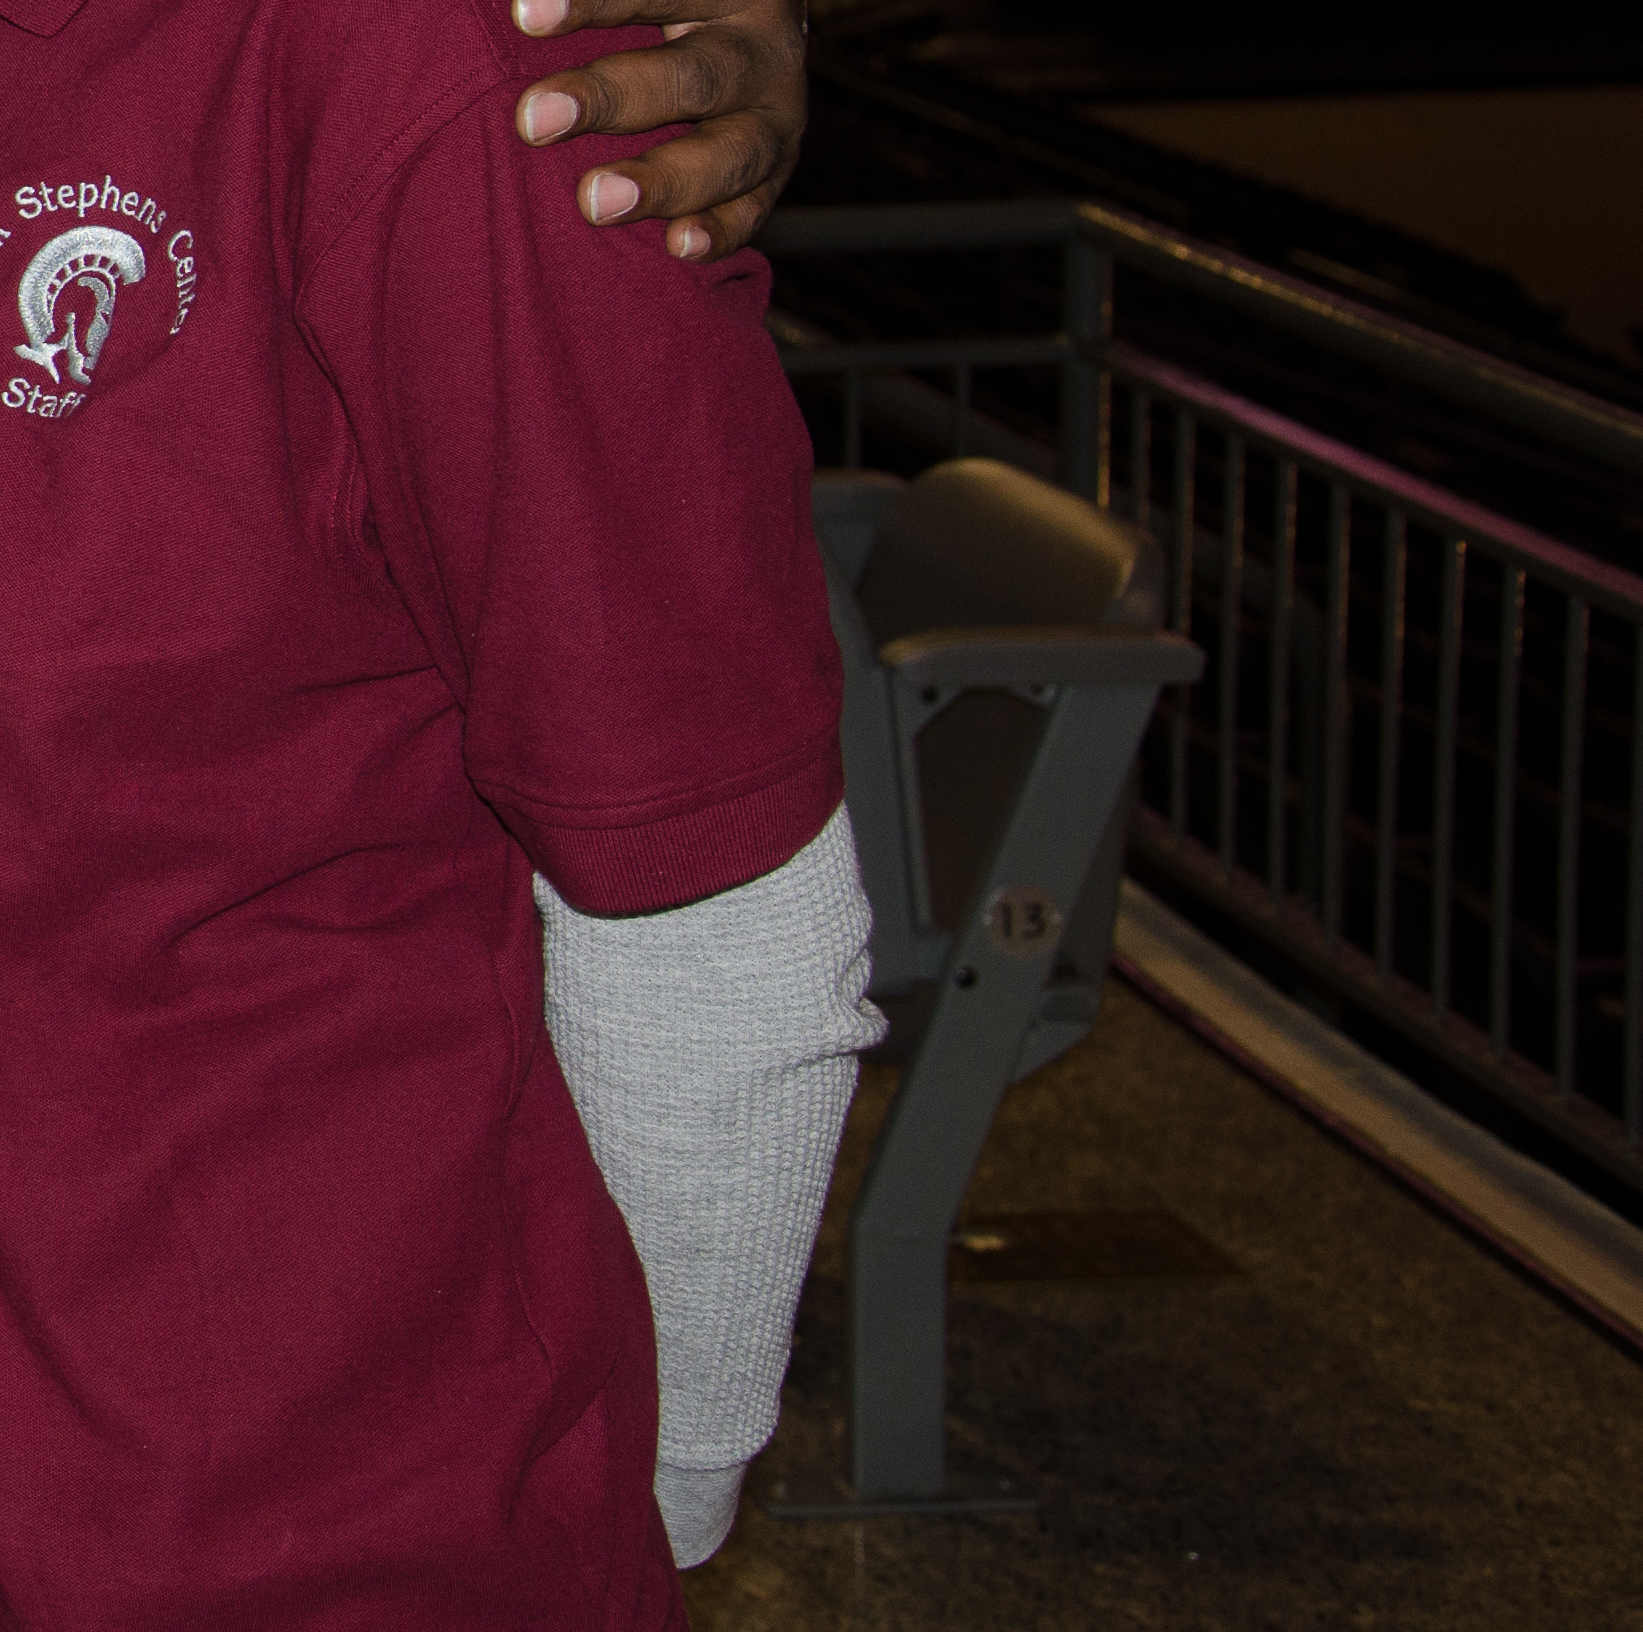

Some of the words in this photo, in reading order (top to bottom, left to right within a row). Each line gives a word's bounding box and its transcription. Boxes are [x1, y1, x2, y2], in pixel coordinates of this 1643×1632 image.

[14, 174, 168, 234] Stephens
[0, 376, 87, 419] Staff
[1000, 900, 1048, 940] 13
